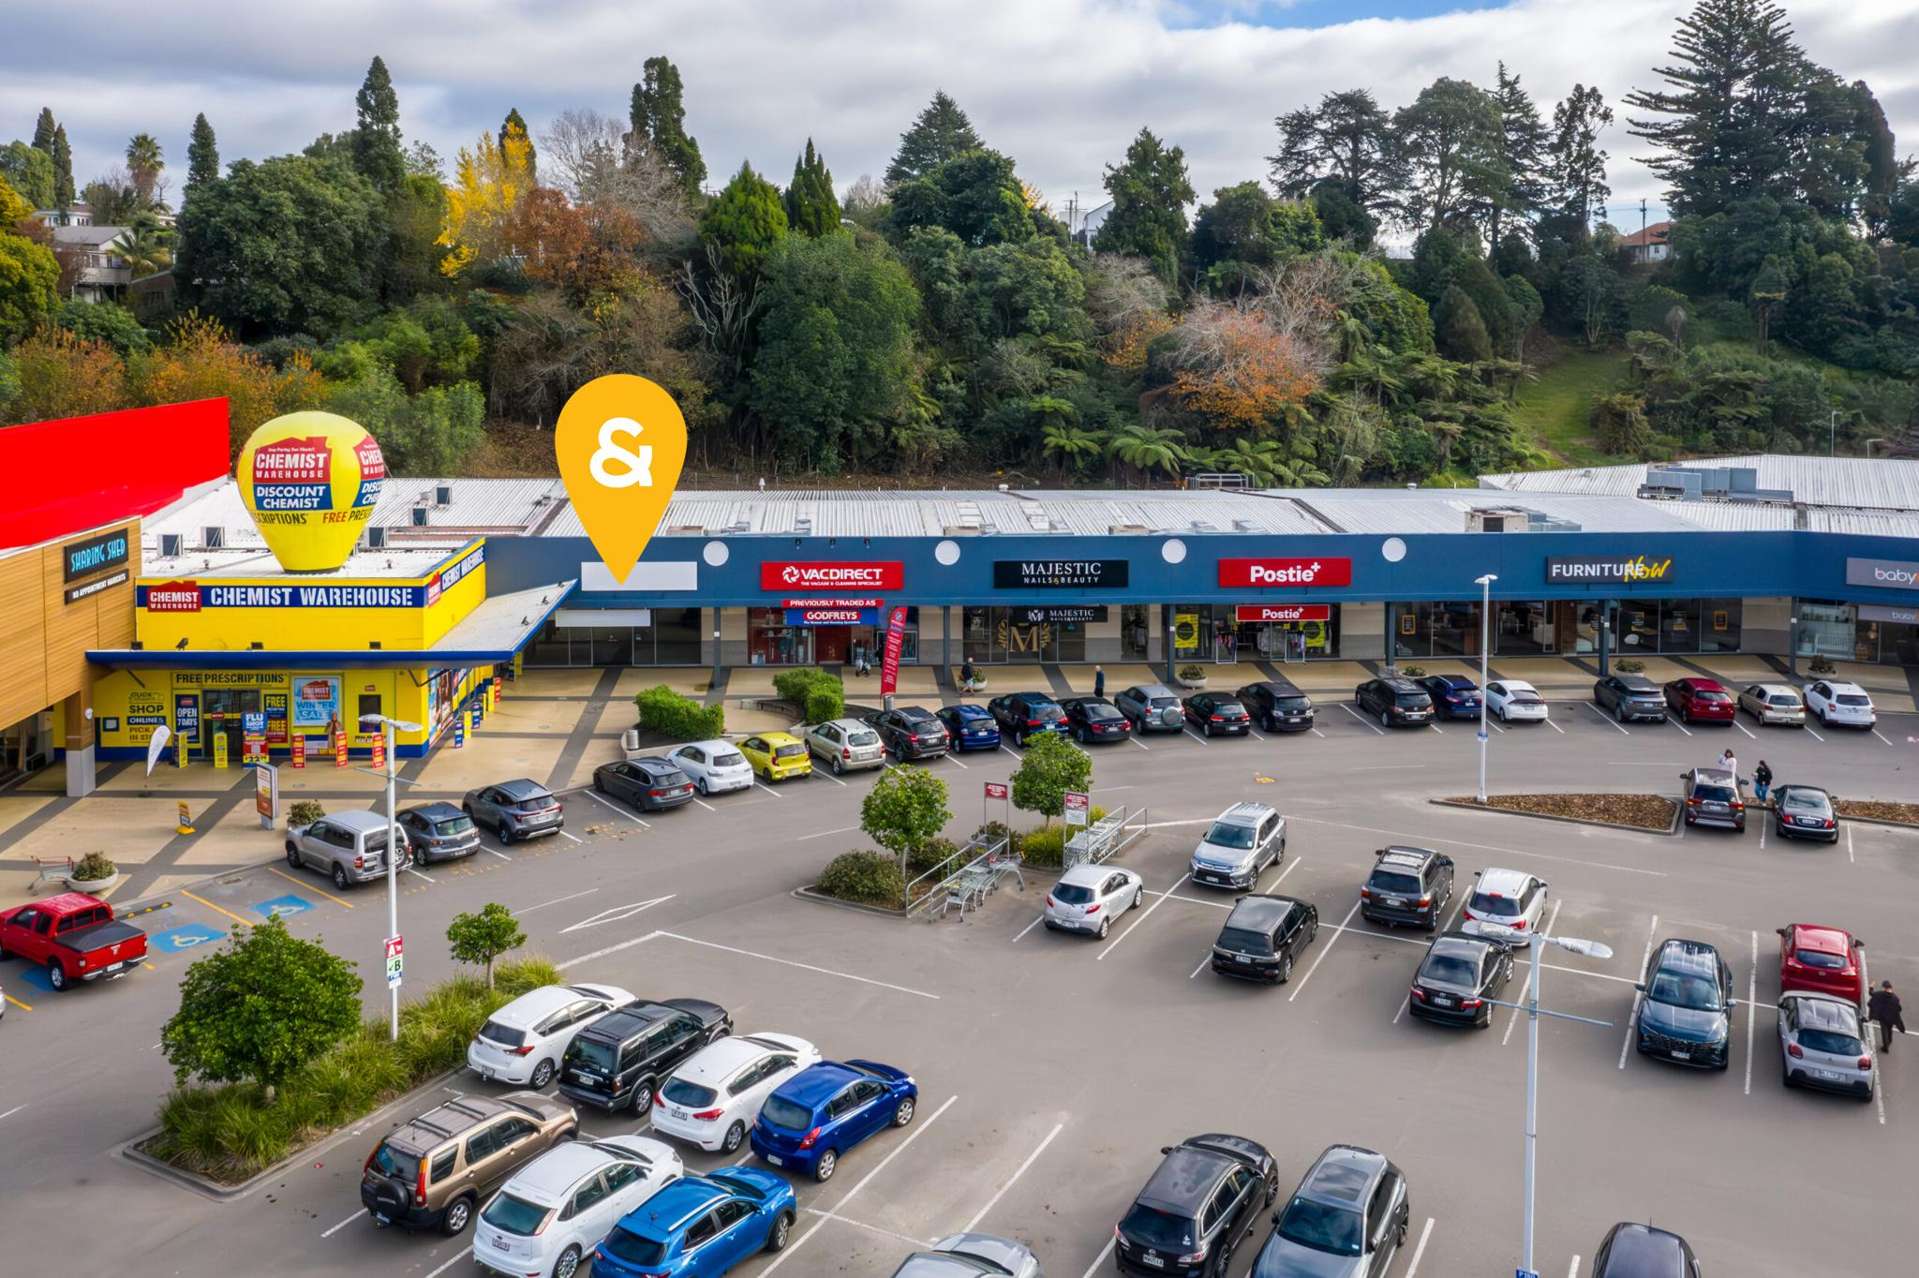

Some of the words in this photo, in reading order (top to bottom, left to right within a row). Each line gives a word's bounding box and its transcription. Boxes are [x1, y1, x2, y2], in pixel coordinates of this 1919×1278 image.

[256, 453, 328, 469] CHEMIST
[256, 470, 324, 478] WAREHOUSE
[256, 486, 326, 497] DISCOUNT
[263, 498, 320, 508] CHEMIST
[322, 511, 348, 523] FREE
[71, 543, 105, 572] SHARING
[107, 537, 126, 560] SHED
[801, 568, 883, 580] VACDIRECT
[1022, 562, 1102, 575] MAJESTIC
[1552, 564, 1645, 577] FURNITURE
[1023, 576, 1052, 584] NAILS
[1060, 576, 1099, 584] BEAUTY
[1875, 567, 1917, 585] baby
[150, 592, 199, 602] CHEMIST
[210, 587, 293, 606] CHEMIST
[299, 587, 413, 606] WAREHOUSE
[807, 611, 857, 620] GODFREYS
[1049, 609, 1094, 617] MAJESTIC
[176, 673, 201, 683] FREE
[204, 673, 284, 683] PRESCRIPTIONS
[266, 696, 286, 707] FREE
[129, 704, 164, 714] SHOP
[177, 707, 197, 718] OPEN
[245, 713, 264, 721] FLU
[394, 960, 401, 971] B
